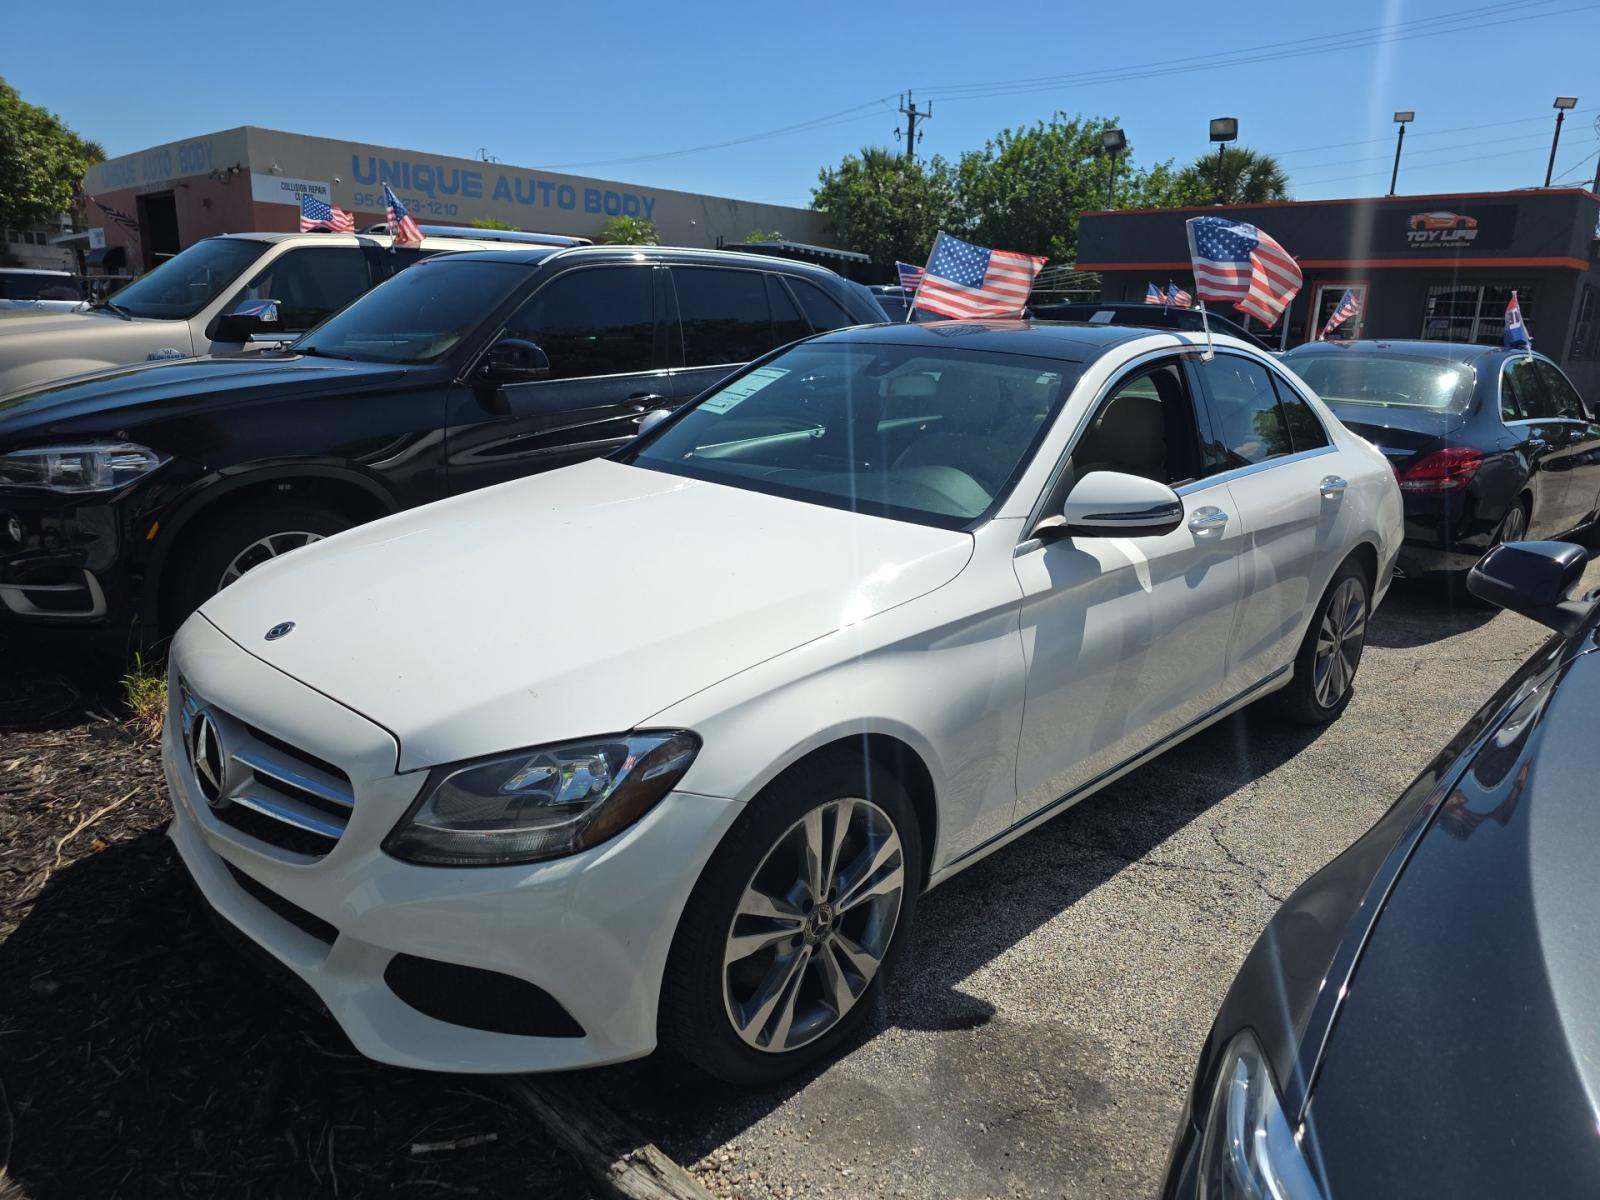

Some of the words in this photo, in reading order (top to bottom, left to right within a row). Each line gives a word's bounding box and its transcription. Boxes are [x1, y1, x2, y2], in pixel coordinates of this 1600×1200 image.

[280, 181, 308, 193] COLLISION
[308, 184, 327, 194] REPAIR
[352, 154, 483, 199] UNIQUE
[493, 174, 576, 210] AUTO
[584, 188, 657, 220] BODY
[1407, 230, 1440, 242] TOY
